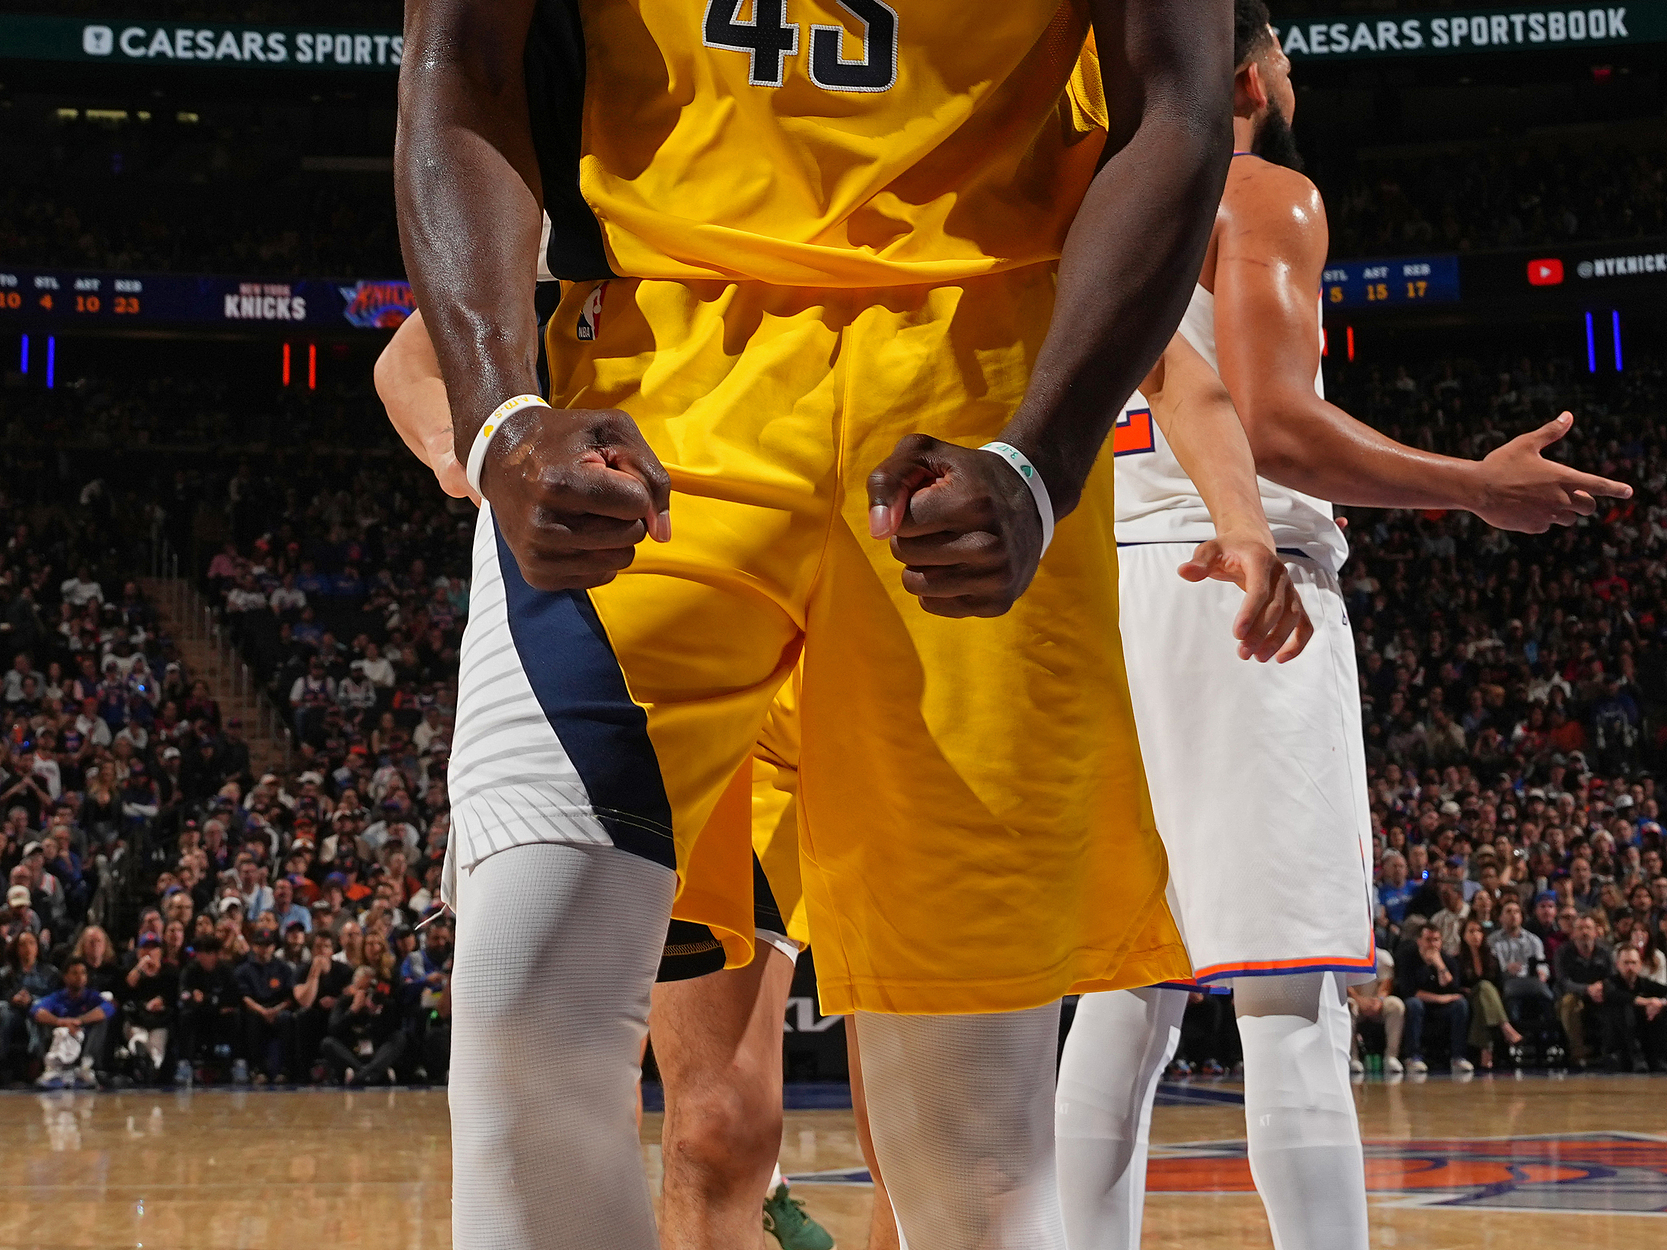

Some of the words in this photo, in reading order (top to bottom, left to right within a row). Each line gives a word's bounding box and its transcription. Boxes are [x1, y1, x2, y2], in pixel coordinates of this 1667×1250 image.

[1271, 19, 1422, 55] AESARS
[1430, 7, 1629, 48] SPORTSBOOK
[120, 27, 288, 62] CAESARS
[1407, 281, 1428, 298] 17
[39, 293, 54, 311] 4
[75, 295, 100, 313] 10
[114, 296, 140, 315] 23
[224, 294, 306, 320] KNICKS
[578, 326, 591, 338] NBA
